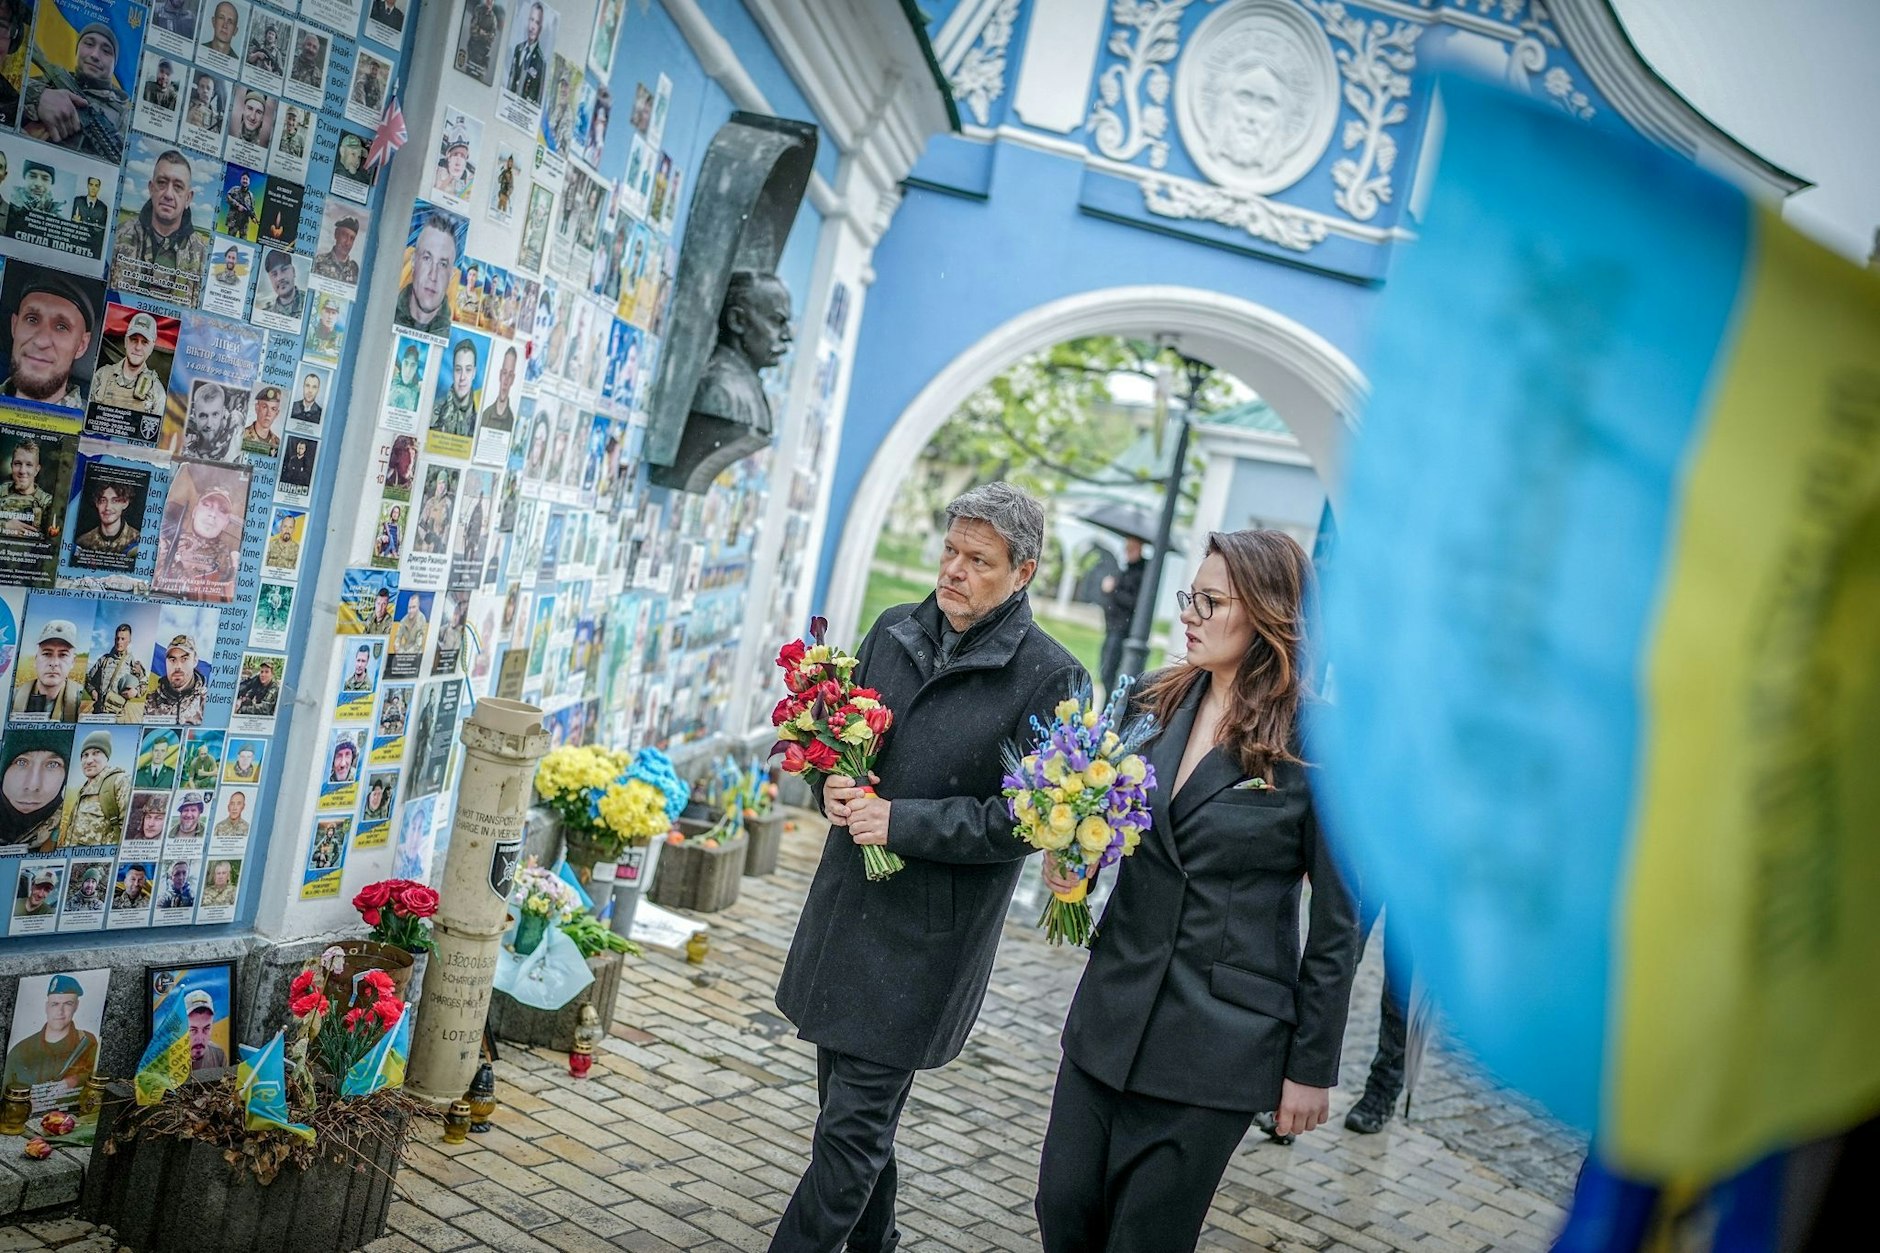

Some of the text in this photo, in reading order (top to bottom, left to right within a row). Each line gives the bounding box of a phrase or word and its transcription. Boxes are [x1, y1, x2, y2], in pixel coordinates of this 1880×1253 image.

[331, 44, 353, 58] знай-
[325, 91, 344, 106] року
[317, 118, 339, 135] Стіни
[316, 134, 336, 151] Сили
[304, 184, 326, 200] Днем
[14, 230, 95, 258] СВІТЛА ПАМ'ЯТЬ
[279, 351, 296, 365] під-
[15, 430, 36, 440] серце
[254, 458, 276, 471] about
[261, 475, 274, 486] the
[251, 489, 271, 502] pho-
[257, 505, 269, 515] on
[257, 520, 266, 529] in
[243, 531, 263, 544] flow-
[242, 548, 261, 559] time
[407, 553, 428, 565] Дмитро
[244, 564, 257, 573] be-
[238, 577, 255, 589] look
[236, 593, 252, 603] was
[231, 621, 247, 631] sol-
[216, 636, 244, 646] enova-
[222, 650, 241, 660] Rus-
[210, 679, 236, 690] Armed
[480, 827, 489, 837] IN
[490, 829, 496, 838] A
[30, 850, 68, 860] support,
[71, 847, 107, 859] funding,
[430, 992, 461, 1009] CHARGES
[442, 1029, 465, 1042] LOT
